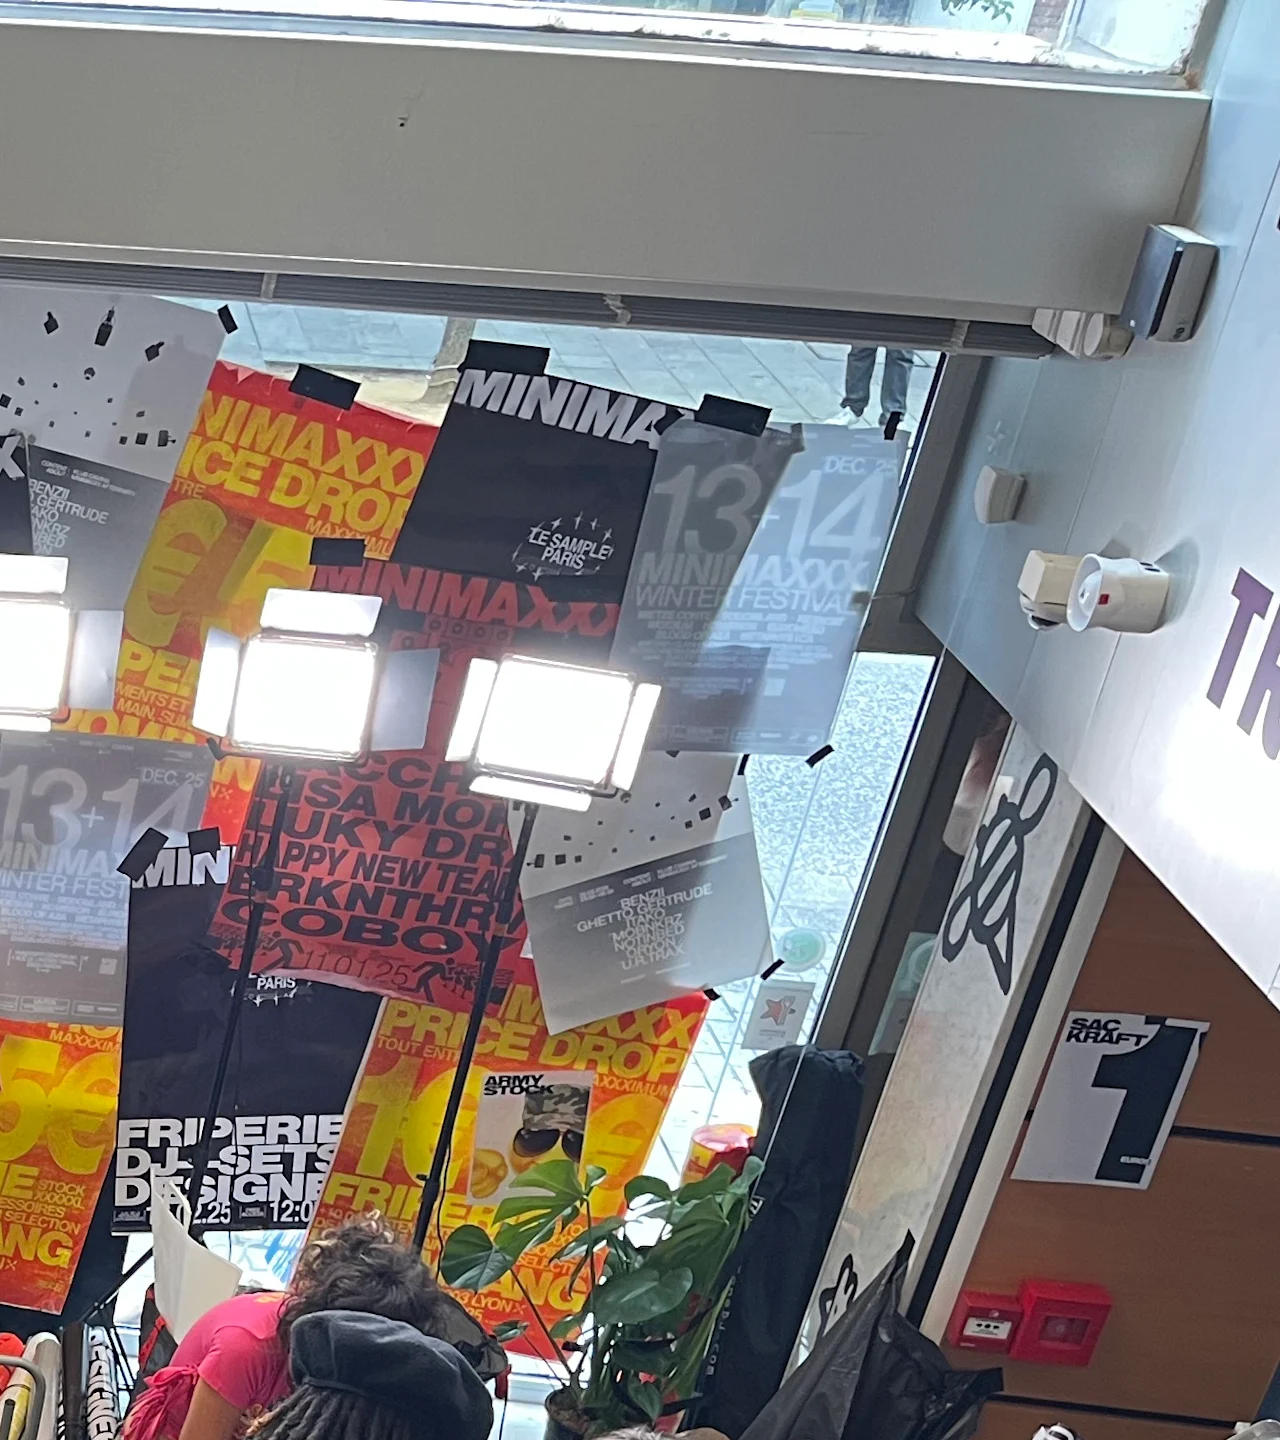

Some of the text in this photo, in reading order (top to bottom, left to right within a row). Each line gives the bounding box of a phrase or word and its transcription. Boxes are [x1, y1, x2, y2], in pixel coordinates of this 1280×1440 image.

[37, 495, 109, 524] GERTRUDE
[529, 529, 608, 561] LE SAMPLE
[541, 546, 586, 570] PARIS
[638, 553, 871, 592] MINIMAXXX
[636, 585, 856, 616] WINTER FESTIVAL
[351, 852, 426, 891] NEW
[577, 883, 713, 932] GHETTO GERTRUDE
[257, 976, 297, 990] PARIS
[1069, 1017, 1122, 1031] SAC
[377, 1036, 419, 1054] TOUT
[383, 1000, 689, 1084] PRICE DROP
[1065, 1030, 1149, 1046] KRAFT
[483, 1084, 554, 1096] STOCK
[484, 1074, 545, 1087] ARMY
[1091, 1022, 1200, 1184] 1
[38, 1180, 86, 1196] STOCK
[4, 1210, 81, 1233] SELECTION
